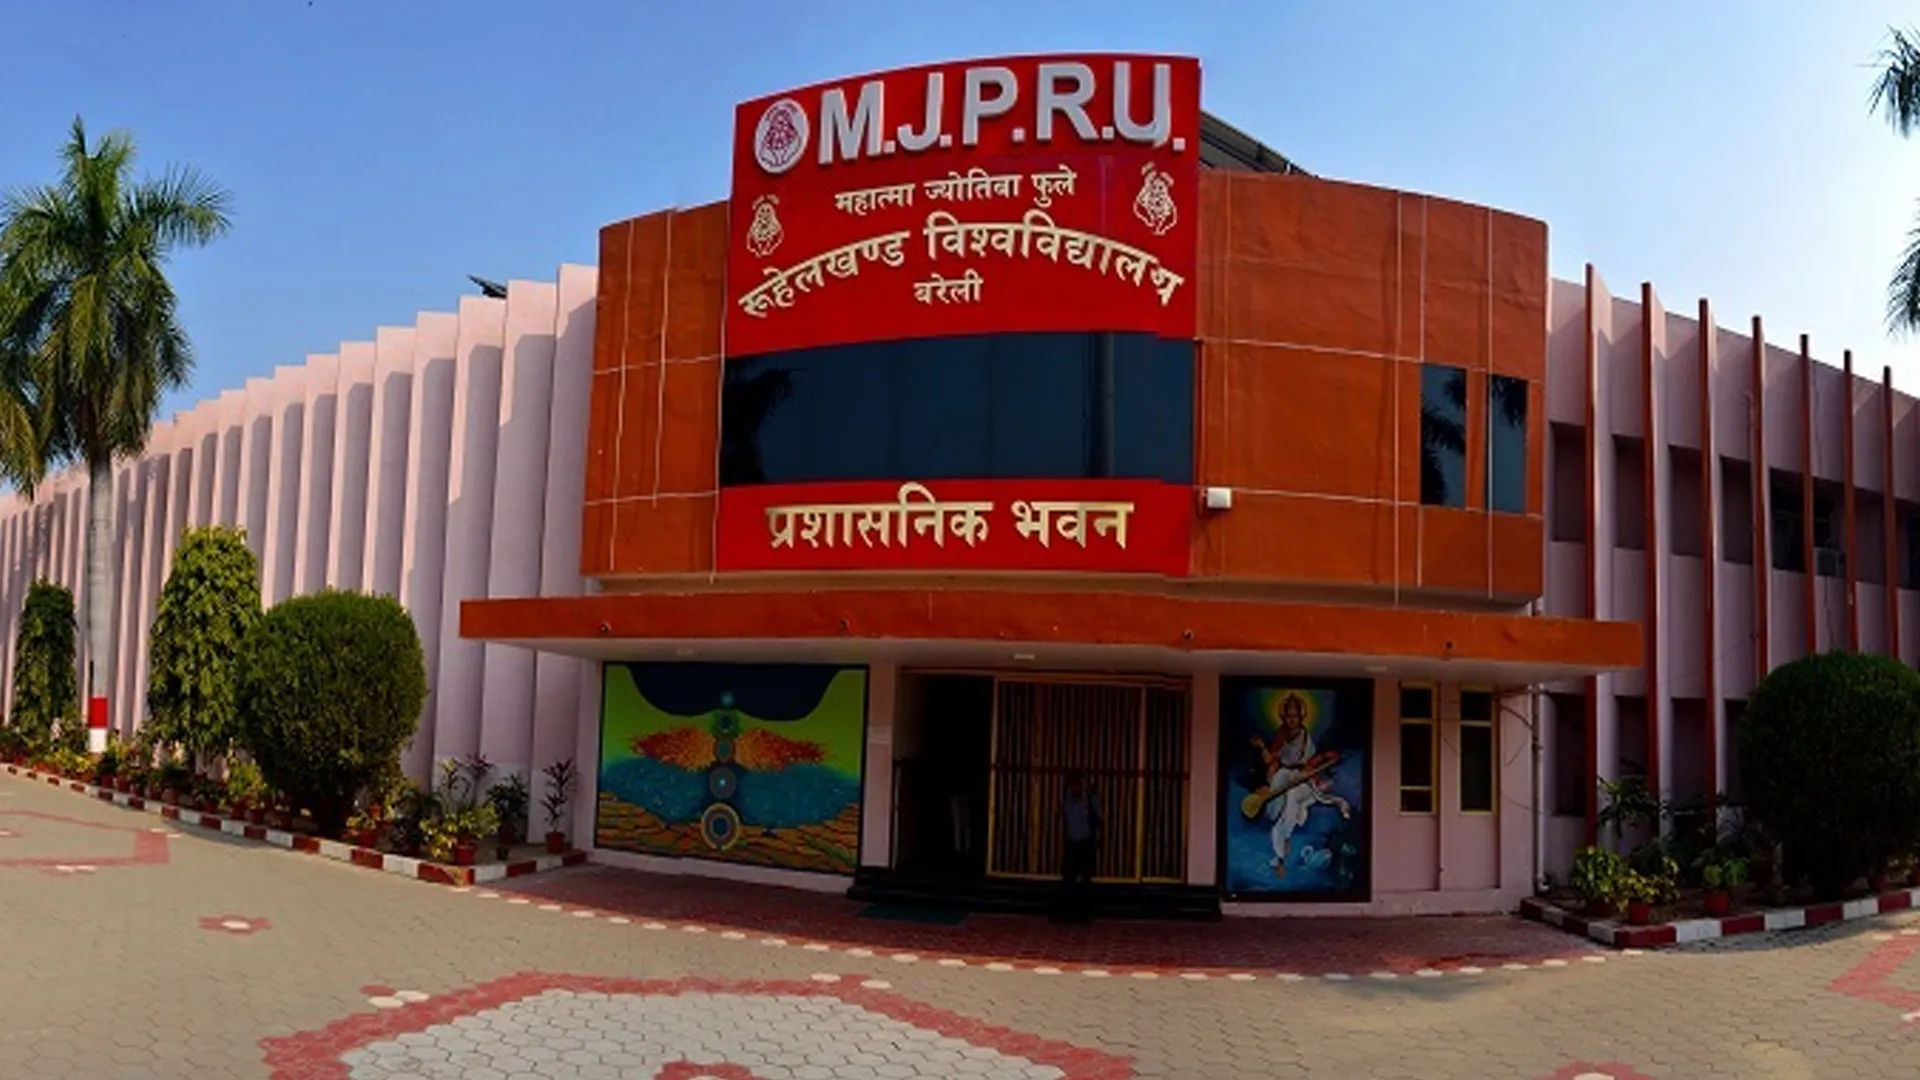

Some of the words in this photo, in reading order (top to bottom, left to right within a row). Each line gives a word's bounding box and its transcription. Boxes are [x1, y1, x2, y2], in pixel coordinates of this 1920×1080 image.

[818, 61, 1186, 166] M.J.P.R.U.
[834, 182, 916, 216] महात्मा
[923, 167, 1024, 202] ज्योतिबा
[1031, 164, 1078, 208] फुले
[737, 230, 912, 318] रूहेलखण्ड
[913, 269, 984, 304] बरेली
[766, 481, 994, 549] प्रशासनिक
[1010, 500, 1135, 550] भवन
